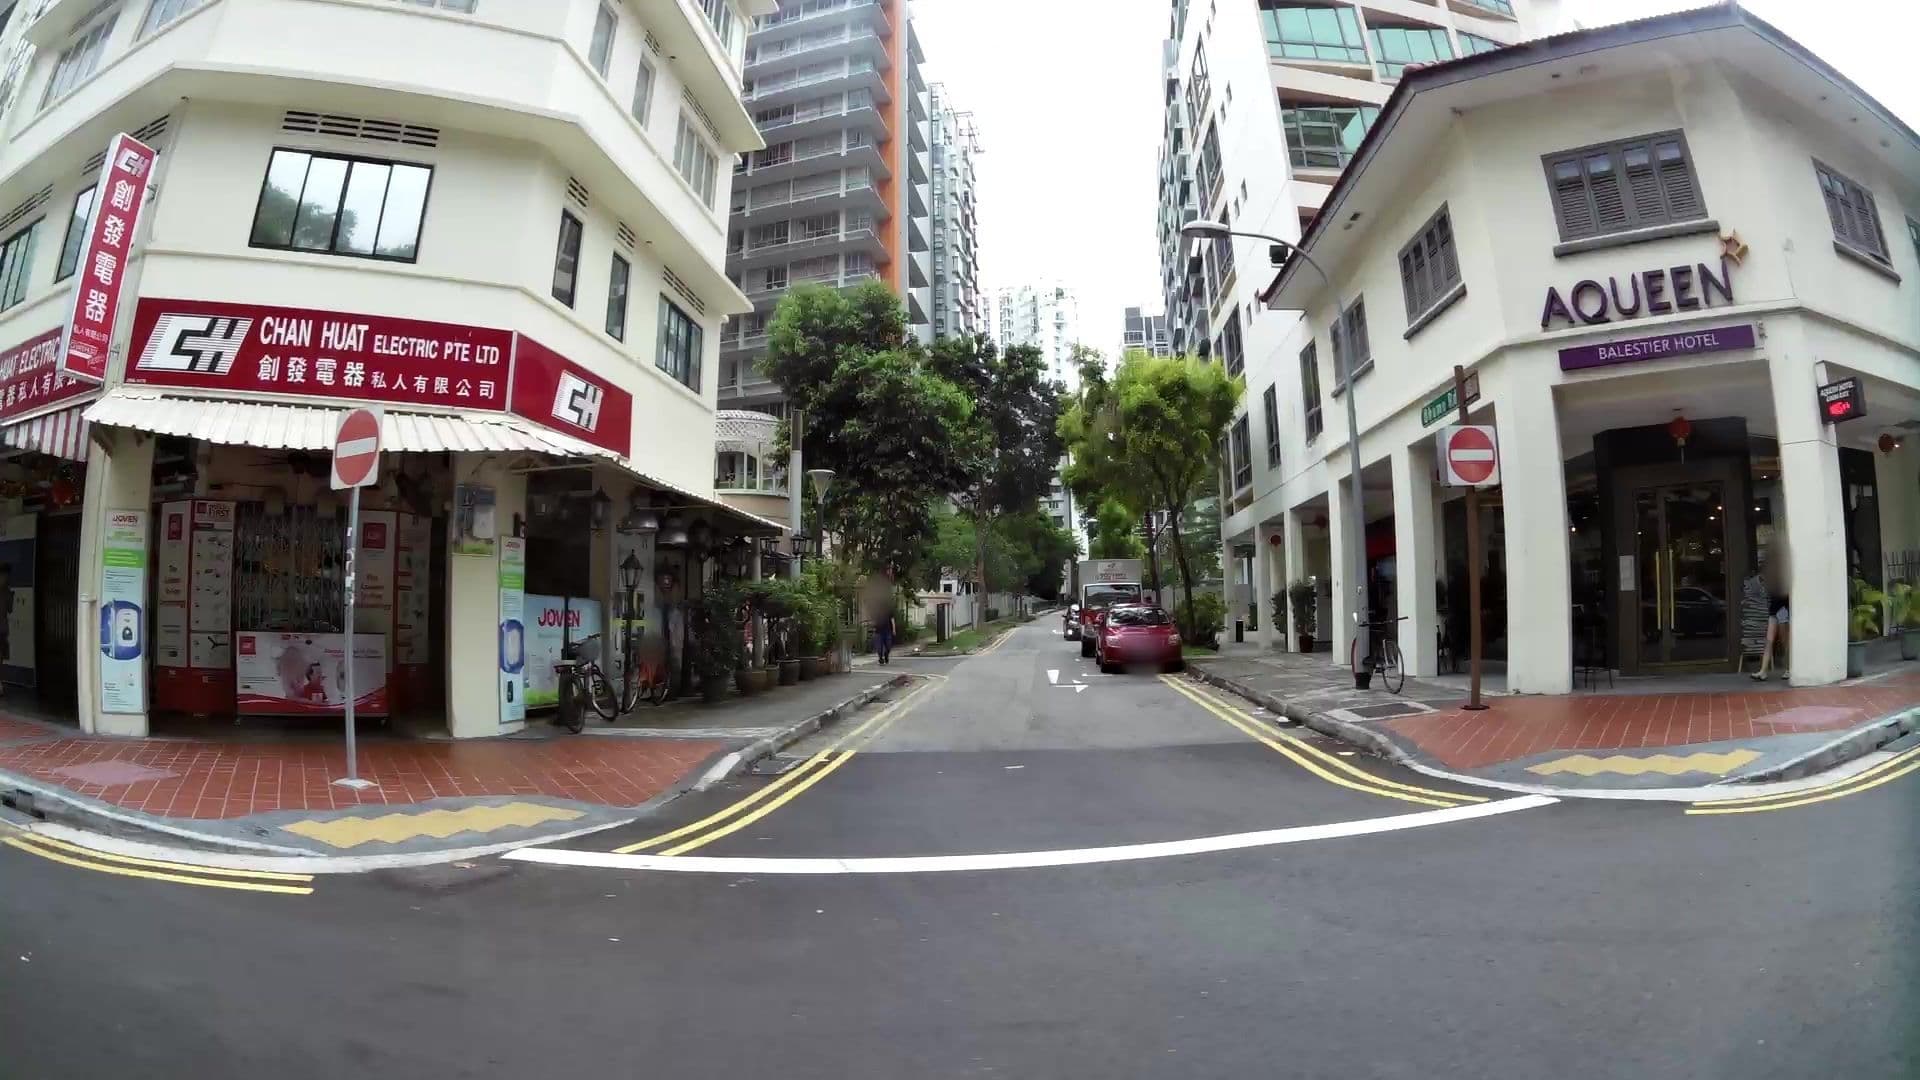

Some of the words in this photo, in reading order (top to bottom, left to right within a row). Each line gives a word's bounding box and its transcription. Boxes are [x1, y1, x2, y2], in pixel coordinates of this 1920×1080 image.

[1541, 256, 1734, 328] AQUEEN
[19, 336, 60, 374] ELECTRIC
[260, 316, 313, 348] CHAN
[320, 321, 369, 352] HUAT
[373, 334, 439, 359] ELECTRIC
[443, 341, 471, 362] PTE
[475, 345, 500, 365] LTD
[1598, 340, 1670, 360] BALESTIER
[1674, 333, 1719, 350] HOTEL
[537, 608, 580, 627] JOVEN
